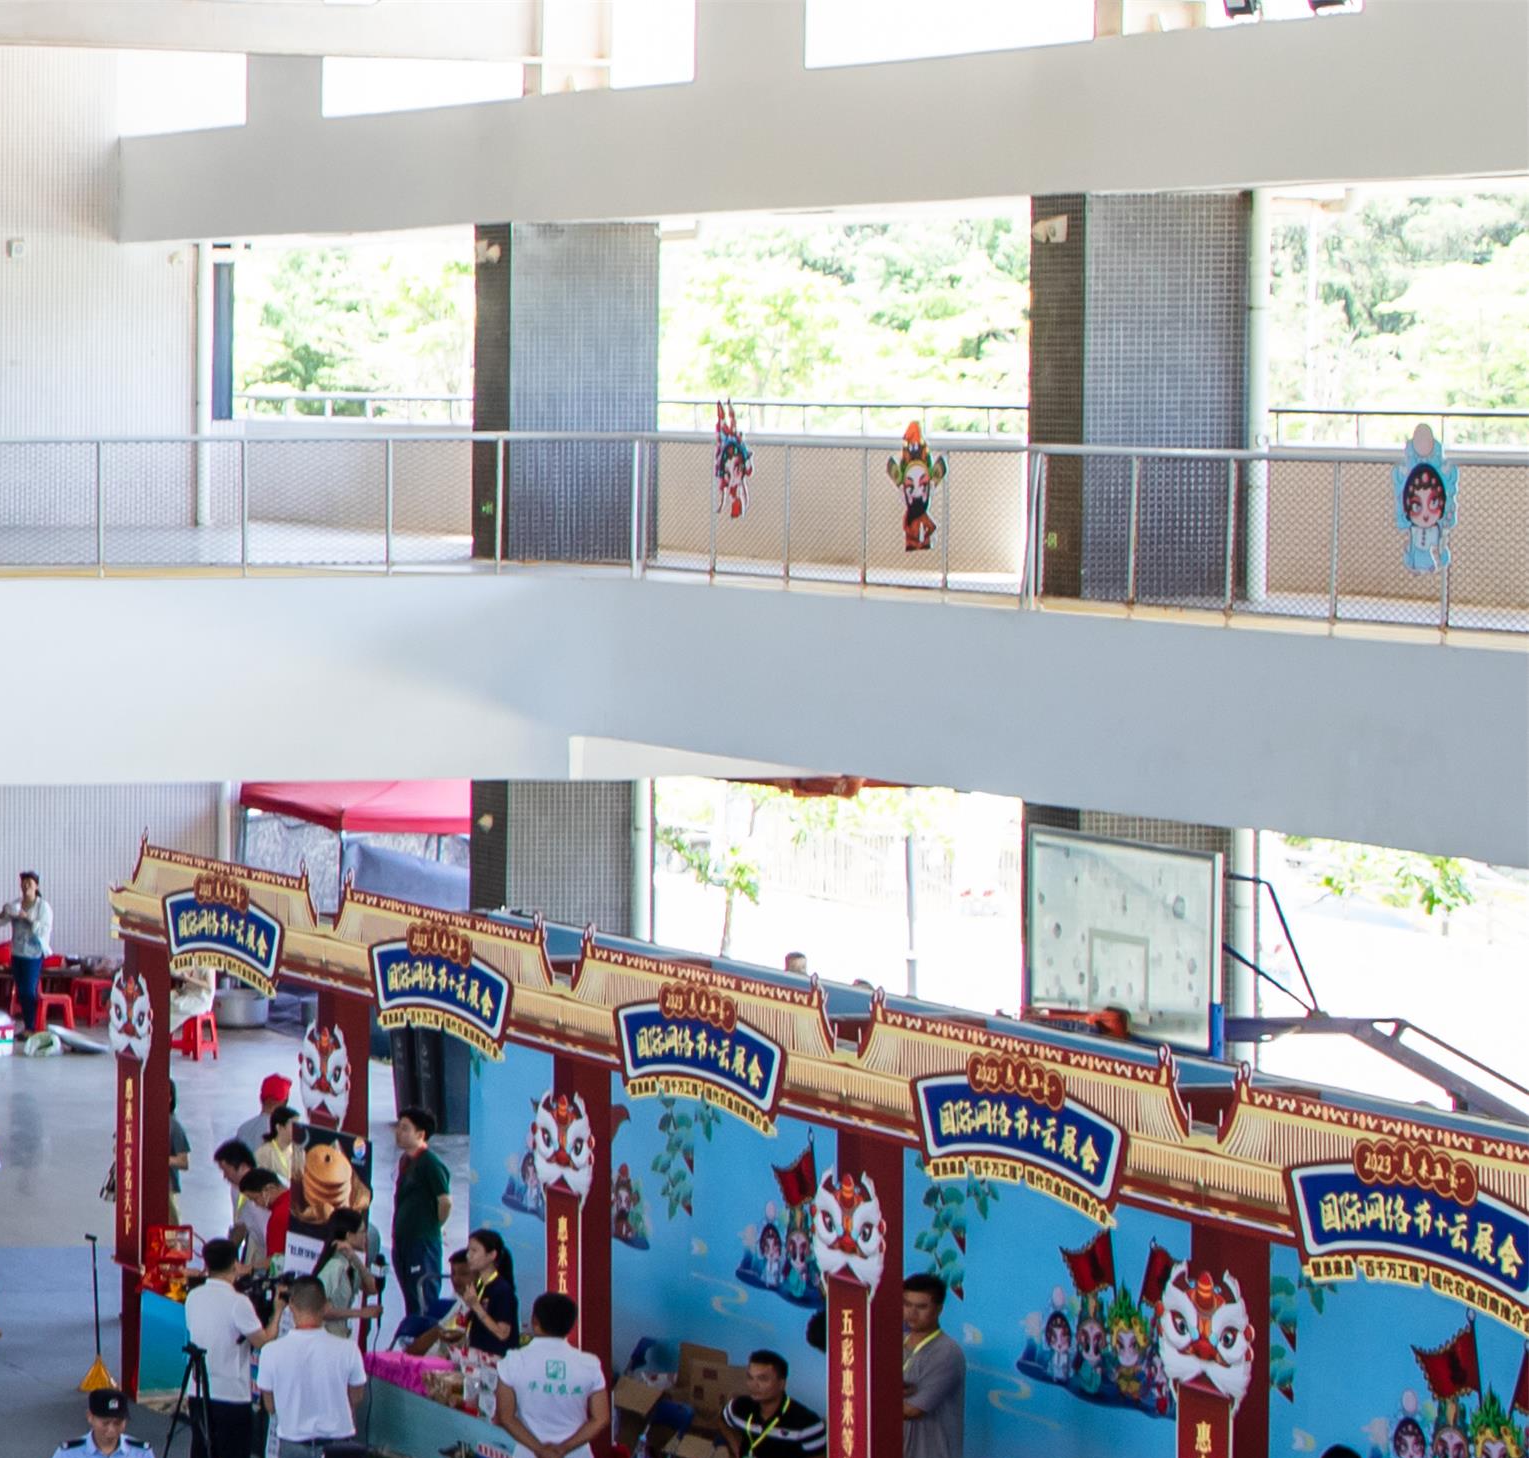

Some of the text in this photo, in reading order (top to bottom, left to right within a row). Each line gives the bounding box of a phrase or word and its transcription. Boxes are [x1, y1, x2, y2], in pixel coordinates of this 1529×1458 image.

[1319, 1192, 1524, 1279] 国际网络节+云展会
